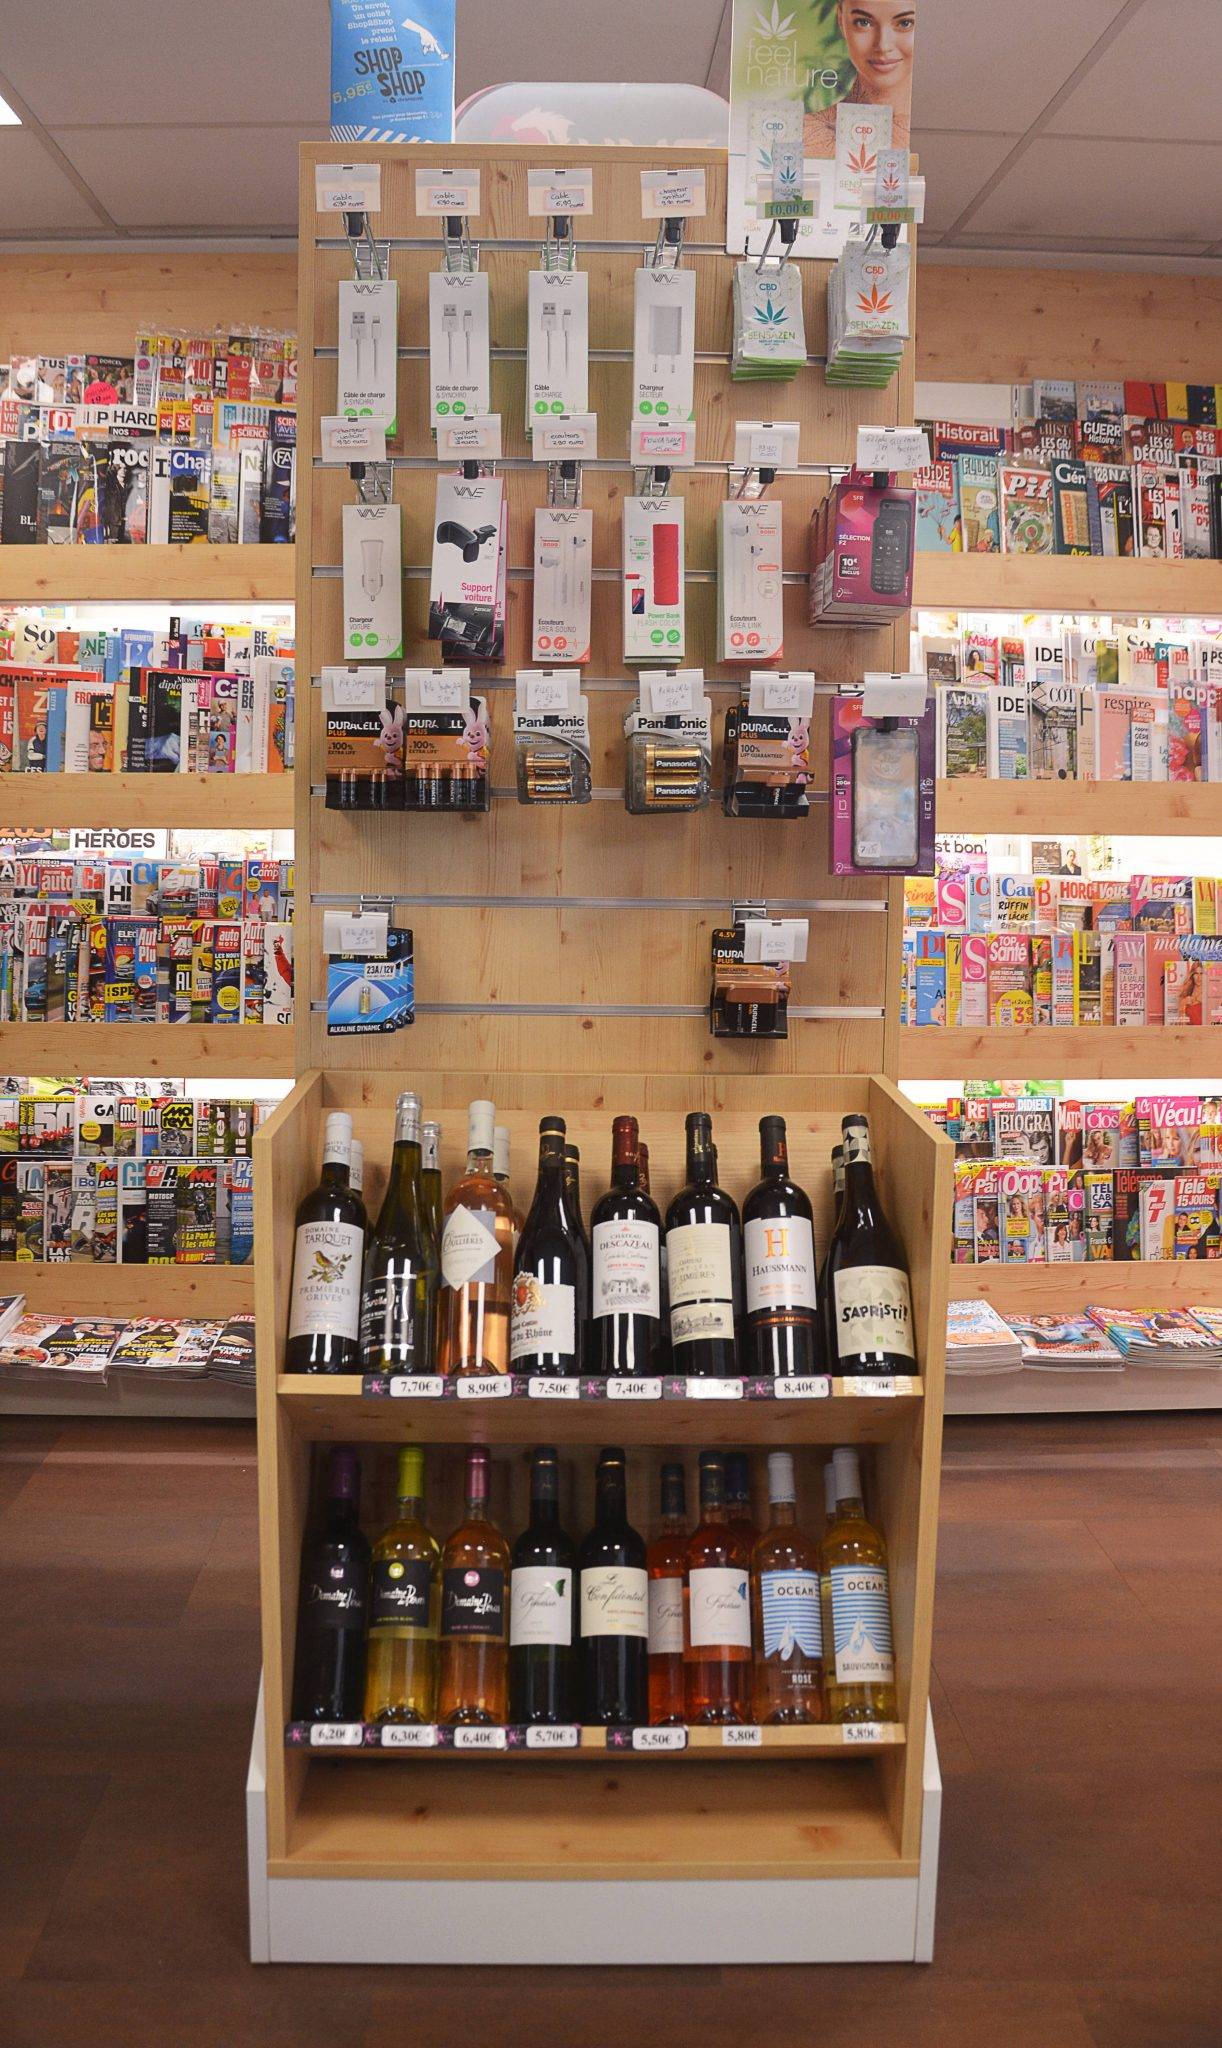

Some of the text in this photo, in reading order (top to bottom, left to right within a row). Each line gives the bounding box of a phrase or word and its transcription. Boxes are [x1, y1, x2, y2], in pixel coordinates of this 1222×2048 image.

[371, 26, 396, 36] prend
[746, 38, 798, 66] feel
[353, 47, 403, 75] SHOP
[746, 63, 839, 89] nature
[376, 70, 426, 97] SHOP
[765, 122, 784, 131] CBD
[855, 126, 873, 134] CBD
[865, 266, 884, 275] CBD
[759, 282, 777, 291] CBD
[850, 319, 900, 331] SENSAZEN
[748, 330, 796, 340] SENSAZEN
[639, 384, 665, 392] Chargeur
[367, 392, 386, 400] charge
[113, 428, 129, 436] NOS
[935, 422, 1000, 443] Historail
[1088, 435, 1115, 445] Histoire
[838, 534, 871, 542] SÉLECTION
[461, 582, 493, 594] Support
[464, 593, 493, 602] voiture
[1104, 696, 1151, 714] respire
[517, 716, 585, 728] Panaonic
[740, 744, 760, 753] 100%
[656, 759, 697, 768] Panasonic
[655, 787, 697, 795] Panasonic
[75, 832, 156, 848] HEROES
[1135, 877, 1187, 901] Astro
[998, 901, 1029, 910] RUFFIN
[998, 912, 1029, 921] NE LÂCHE
[219, 929, 240, 941] auto
[1000, 936, 1018, 946] TOP
[989, 941, 1027, 962] Santé
[1119, 991, 1132, 999] EST
[1119, 999, 1139, 1007] ARME
[356, 1024, 381, 1032] DYNAMIC
[1017, 1099, 1045, 1111] DIDIER
[1152, 1101, 1202, 1127] Vécu!
[1177, 1179, 1206, 1194] Télé
[1177, 1194, 1215, 1207] 15 JOURS
[305, 1227, 339, 1235] DOMAINE
[305, 1232, 353, 1247] TARIQUET
[764, 1228, 790, 1258] H
[600, 1240, 653, 1251] DESCAZEAU
[752, 1264, 807, 1277] HAUSSMANN
[306, 1293, 344, 1302] GRIVES
[524, 1327, 553, 1338] Rhône
[401, 1381, 433, 1394] 7,70€
[467, 1382, 500, 1394] 8,90€
[538, 1382, 571, 1394] 7,50€
[615, 1382, 647, 1394] 7,40€
[784, 1382, 815, 1394] 8,40€
[777, 1586, 814, 1596] OCEAN
[847, 1581, 884, 1591] OCEAN
[842, 1662, 880, 1672] SAUVIGNON
[390, 1730, 422, 1742] 6,30€
[462, 1732, 494, 1743] 6,40€
[534, 1730, 566, 1742] 5,70€
[640, 1734, 672, 1745] 5,50€
[727, 1730, 759, 1742] 5,80€
